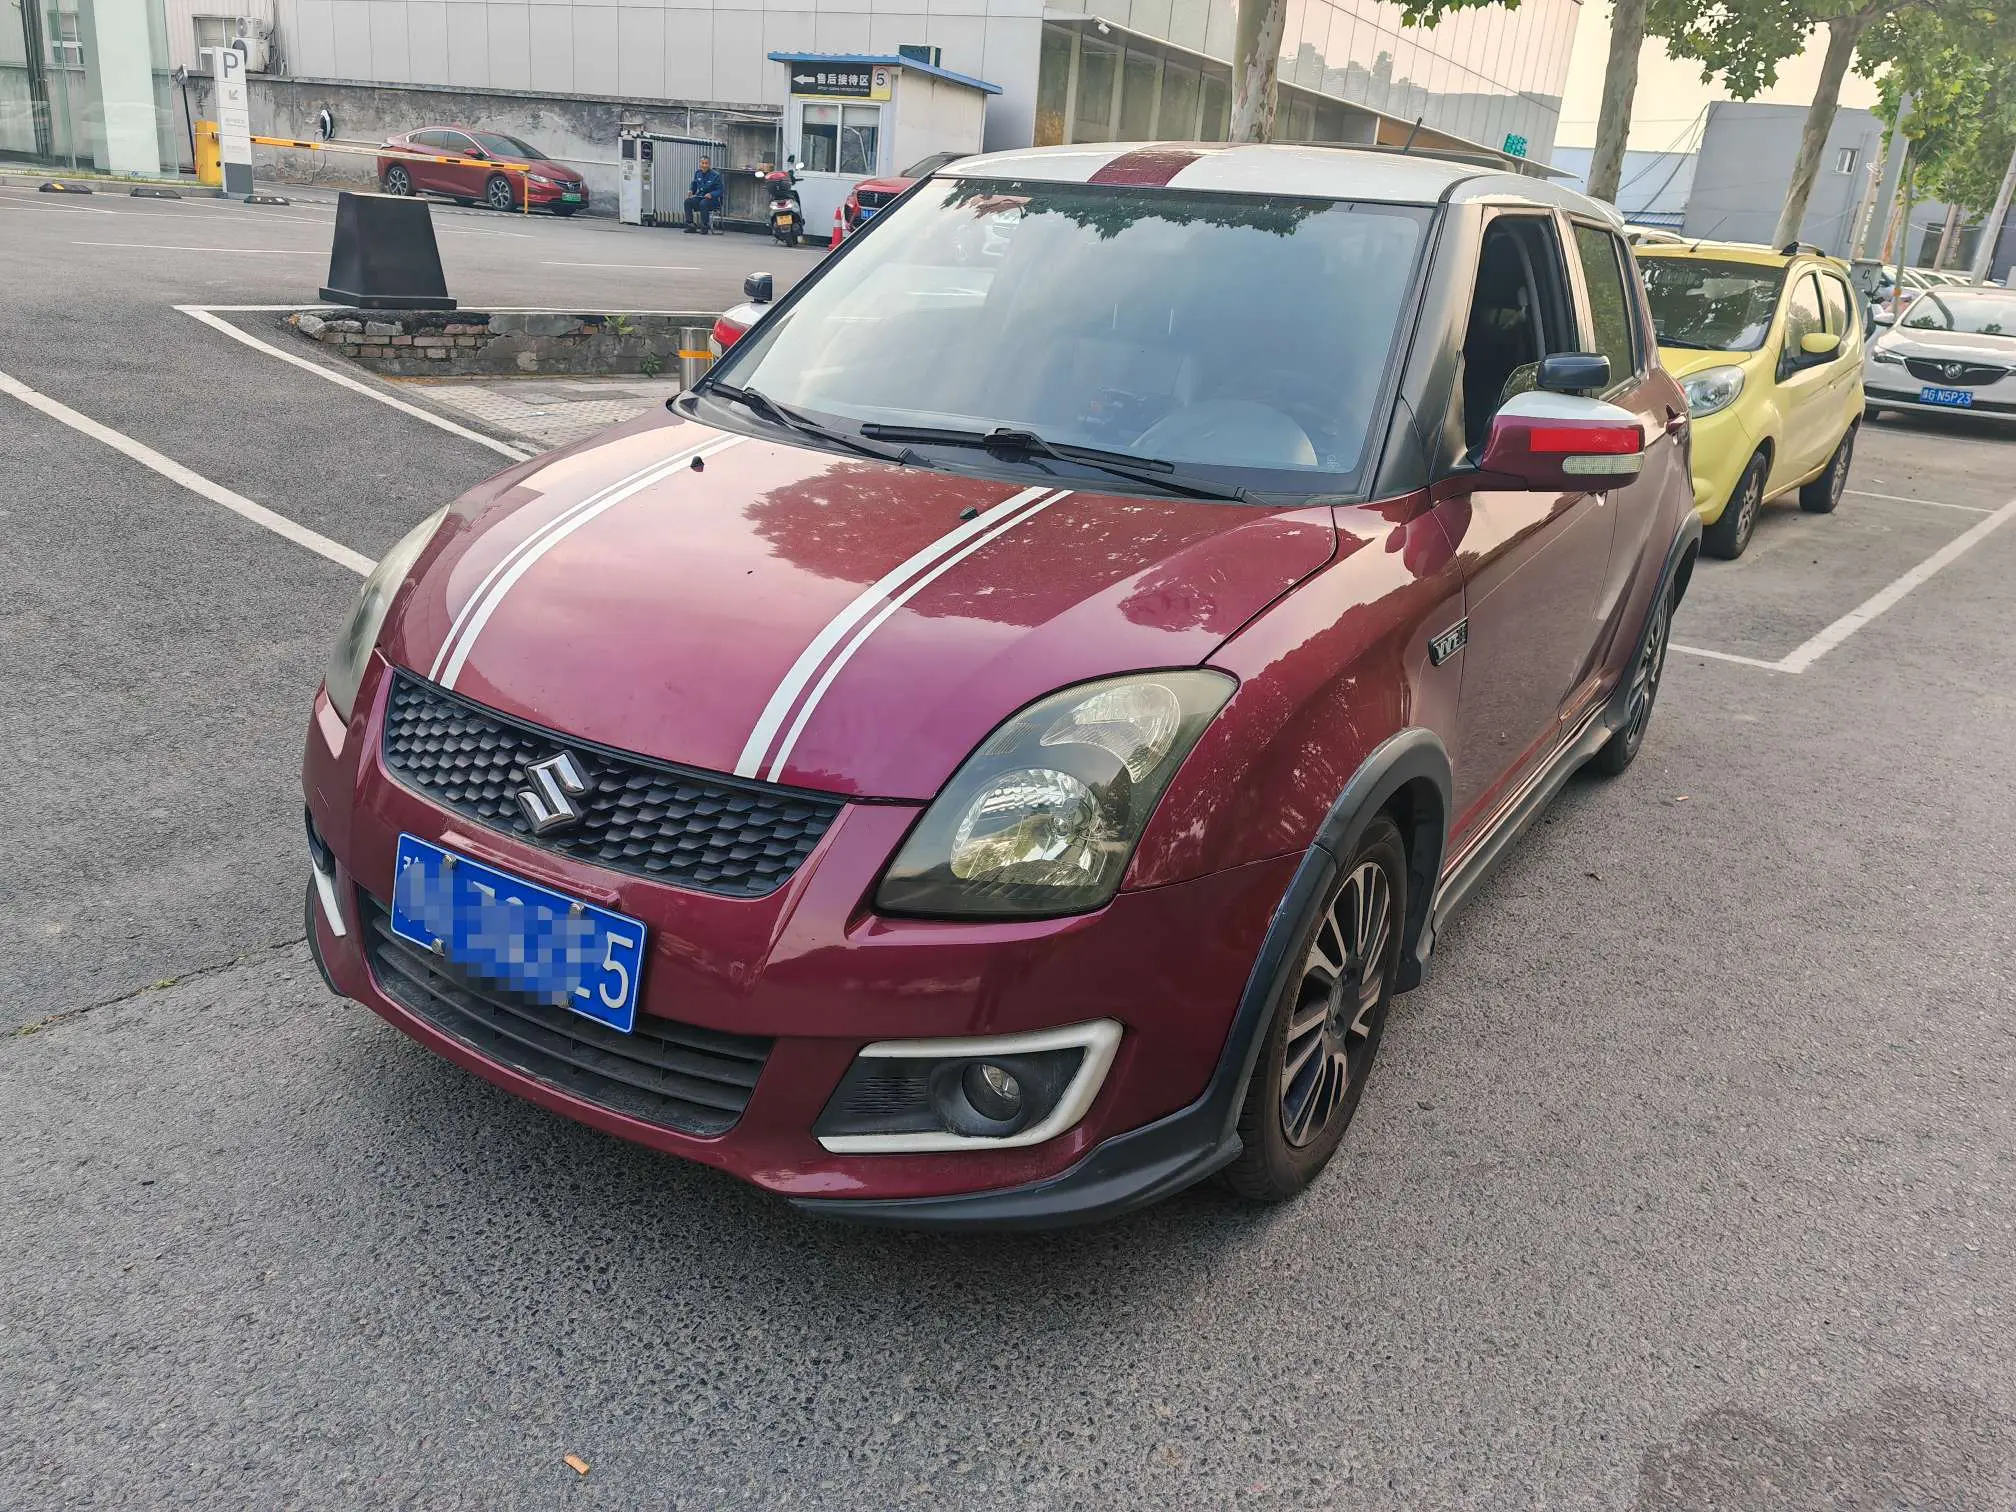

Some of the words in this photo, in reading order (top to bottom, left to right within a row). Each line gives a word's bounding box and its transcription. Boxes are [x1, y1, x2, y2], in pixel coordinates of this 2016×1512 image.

[223, 52, 238, 78] P
[816, 73, 869, 86] 售后接待区
[876, 73, 884, 86] 5
